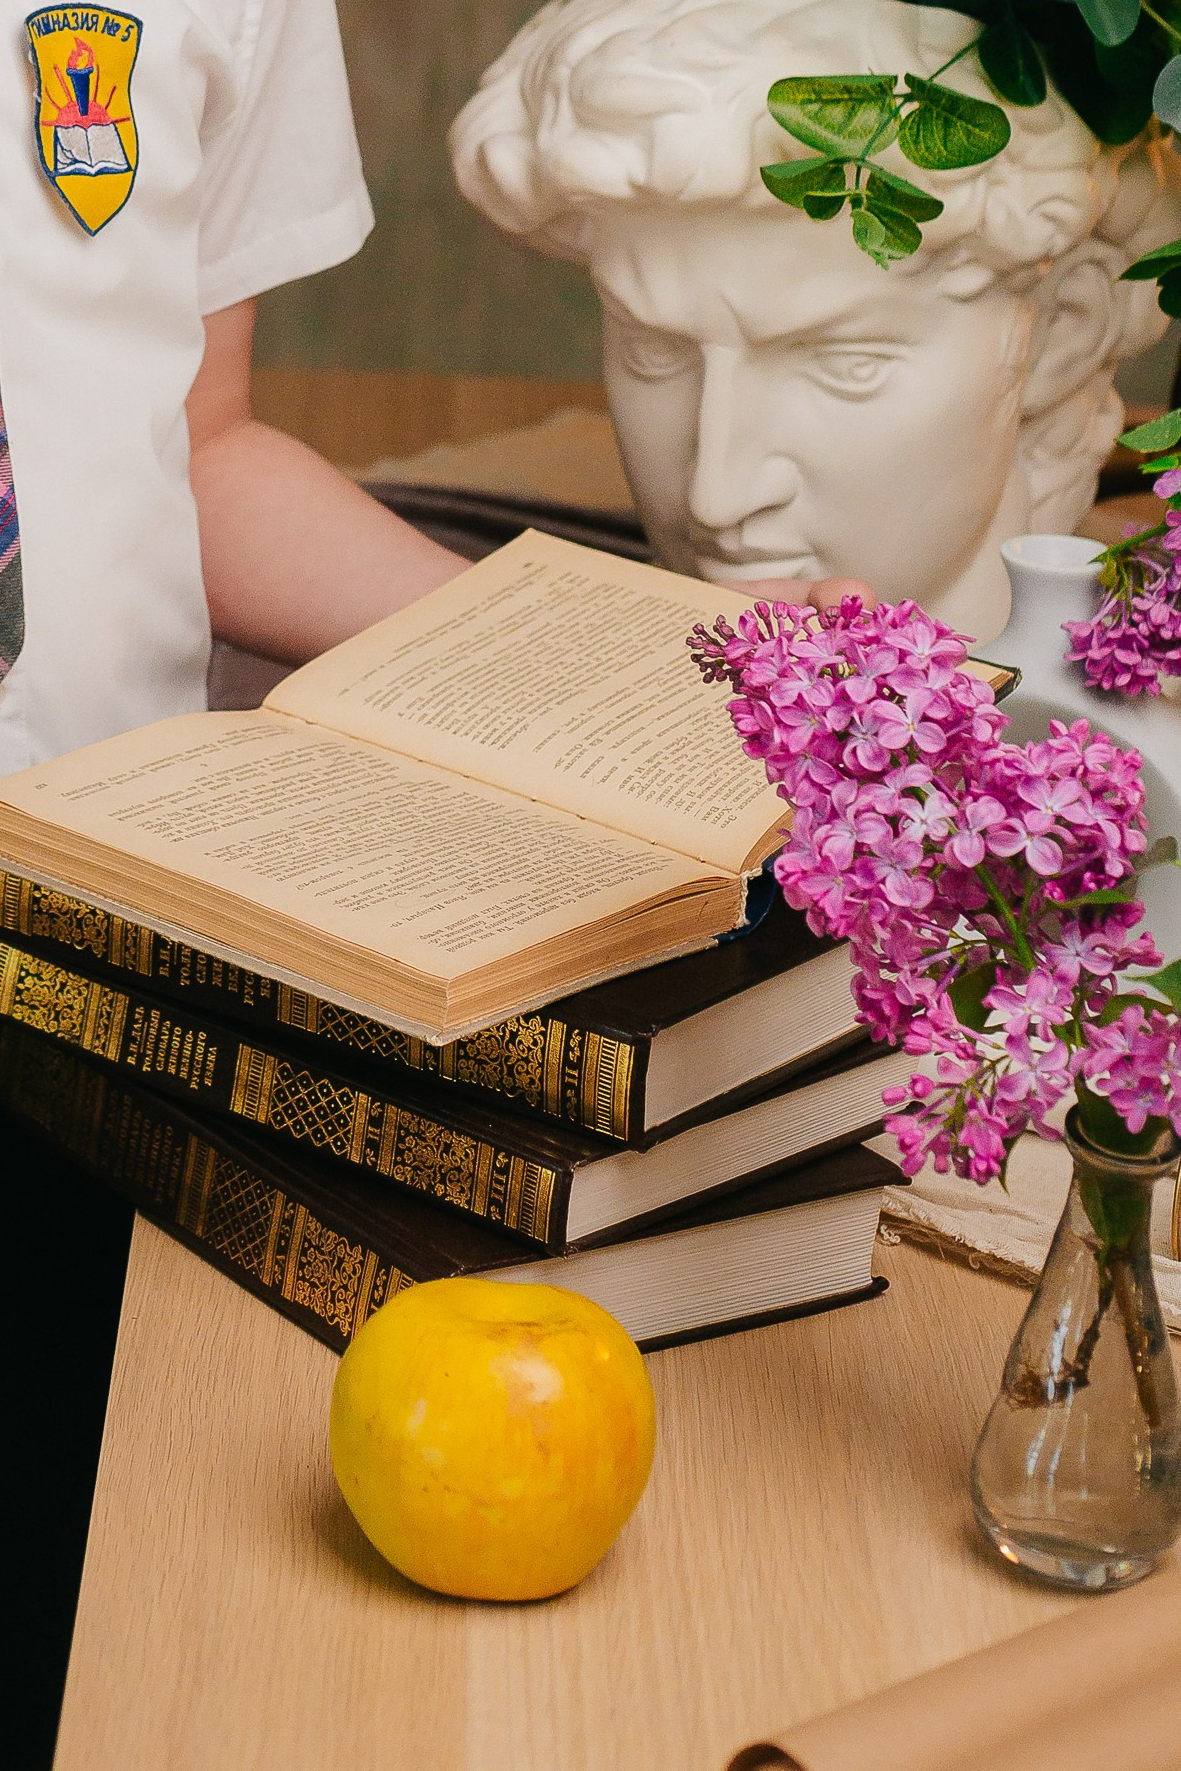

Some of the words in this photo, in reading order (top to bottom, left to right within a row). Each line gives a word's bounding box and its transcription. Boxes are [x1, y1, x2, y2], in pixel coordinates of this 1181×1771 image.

[30, 11, 99, 39] ГИМНАЗИЯ
[120, 23, 135, 42] 5
[142, 1008, 161, 1072] ТОЛКОВЫЙ
[155, 1020, 172, 1071] СЛОВАРЬ
[167, 1026, 182, 1075] ЖИВОГО
[179, 1030, 194, 1079] ВЕЛИКО-
[189, 1031, 207, 1090] РУССКОГО
[203, 1046, 219, 1087] ЯЗЫКА
